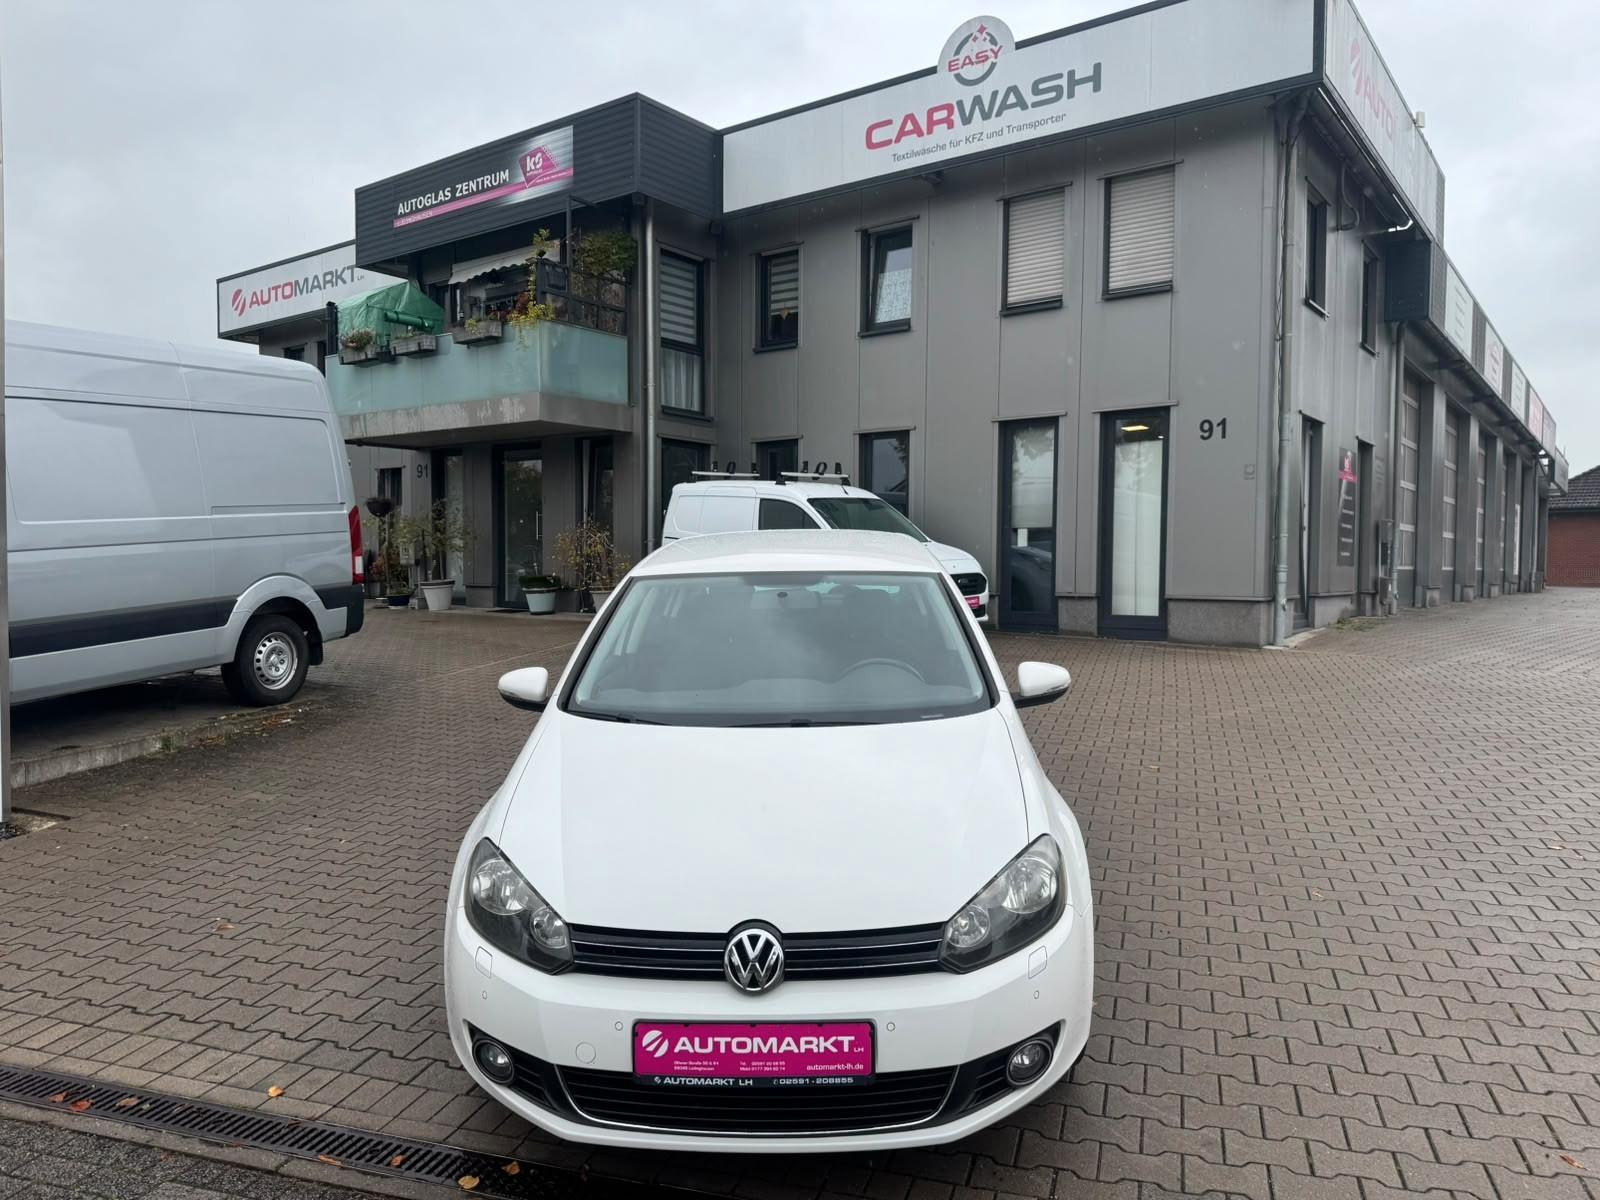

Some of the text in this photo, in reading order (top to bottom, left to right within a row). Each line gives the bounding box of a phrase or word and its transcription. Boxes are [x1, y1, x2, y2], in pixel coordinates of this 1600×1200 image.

[947, 45, 1003, 73] EASY
[865, 61, 1102, 150] CARWASH
[892, 113, 1067, 163] Textilwäsche für KFZ und Transporter
[397, 187, 452, 216] AUTOGLAS
[455, 168, 510, 198] ZENTRUM
[249, 264, 357, 309] AUTOMARKT
[1199, 417, 1228, 441] 91
[416, 463, 429, 479] 91
[673, 1035, 856, 1054] AUTOMARKT
[806, 1063, 865, 1071] automarkt-lh.de
[664, 1077, 736, 1086] AUTOMARKT
[738, 1078, 754, 1086] LH
